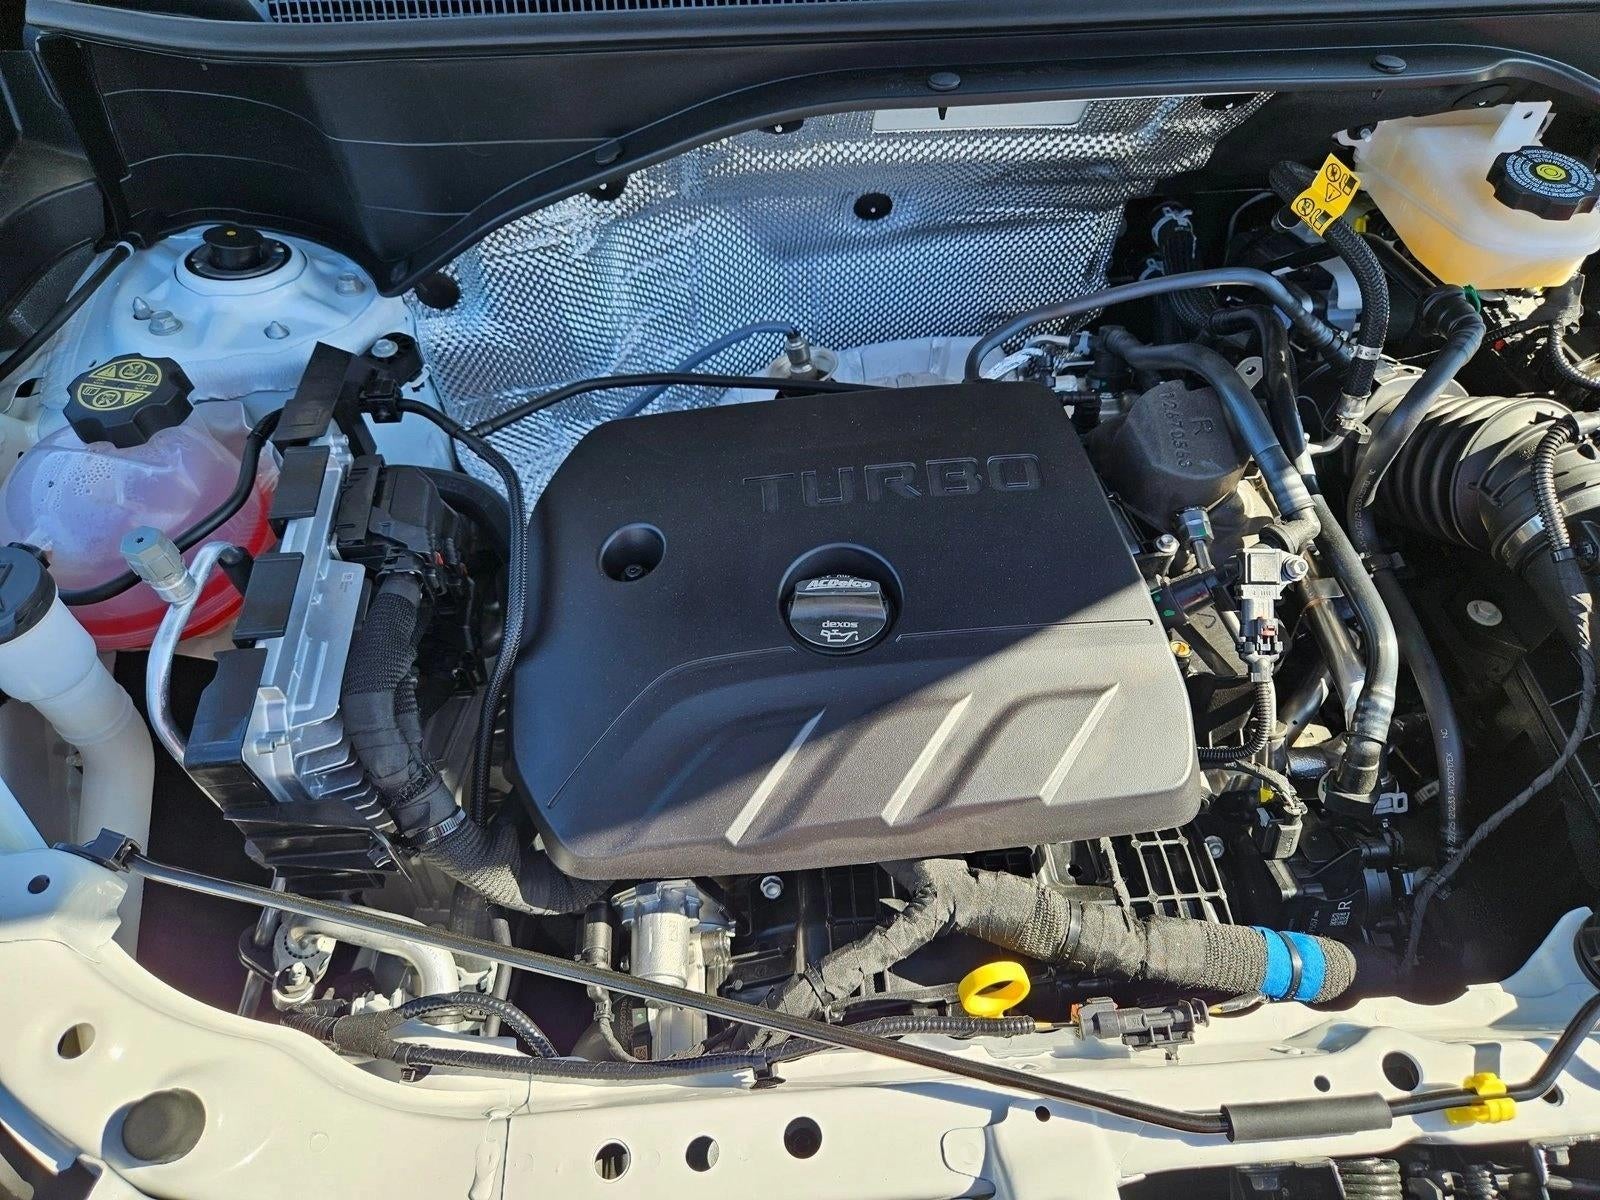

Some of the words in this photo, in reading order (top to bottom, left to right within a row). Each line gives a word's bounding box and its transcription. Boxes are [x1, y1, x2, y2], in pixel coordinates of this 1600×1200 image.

[743, 453, 1041, 513] TURBO
[805, 579, 872, 590] ACDelco
[822, 620, 858, 628] dexos
